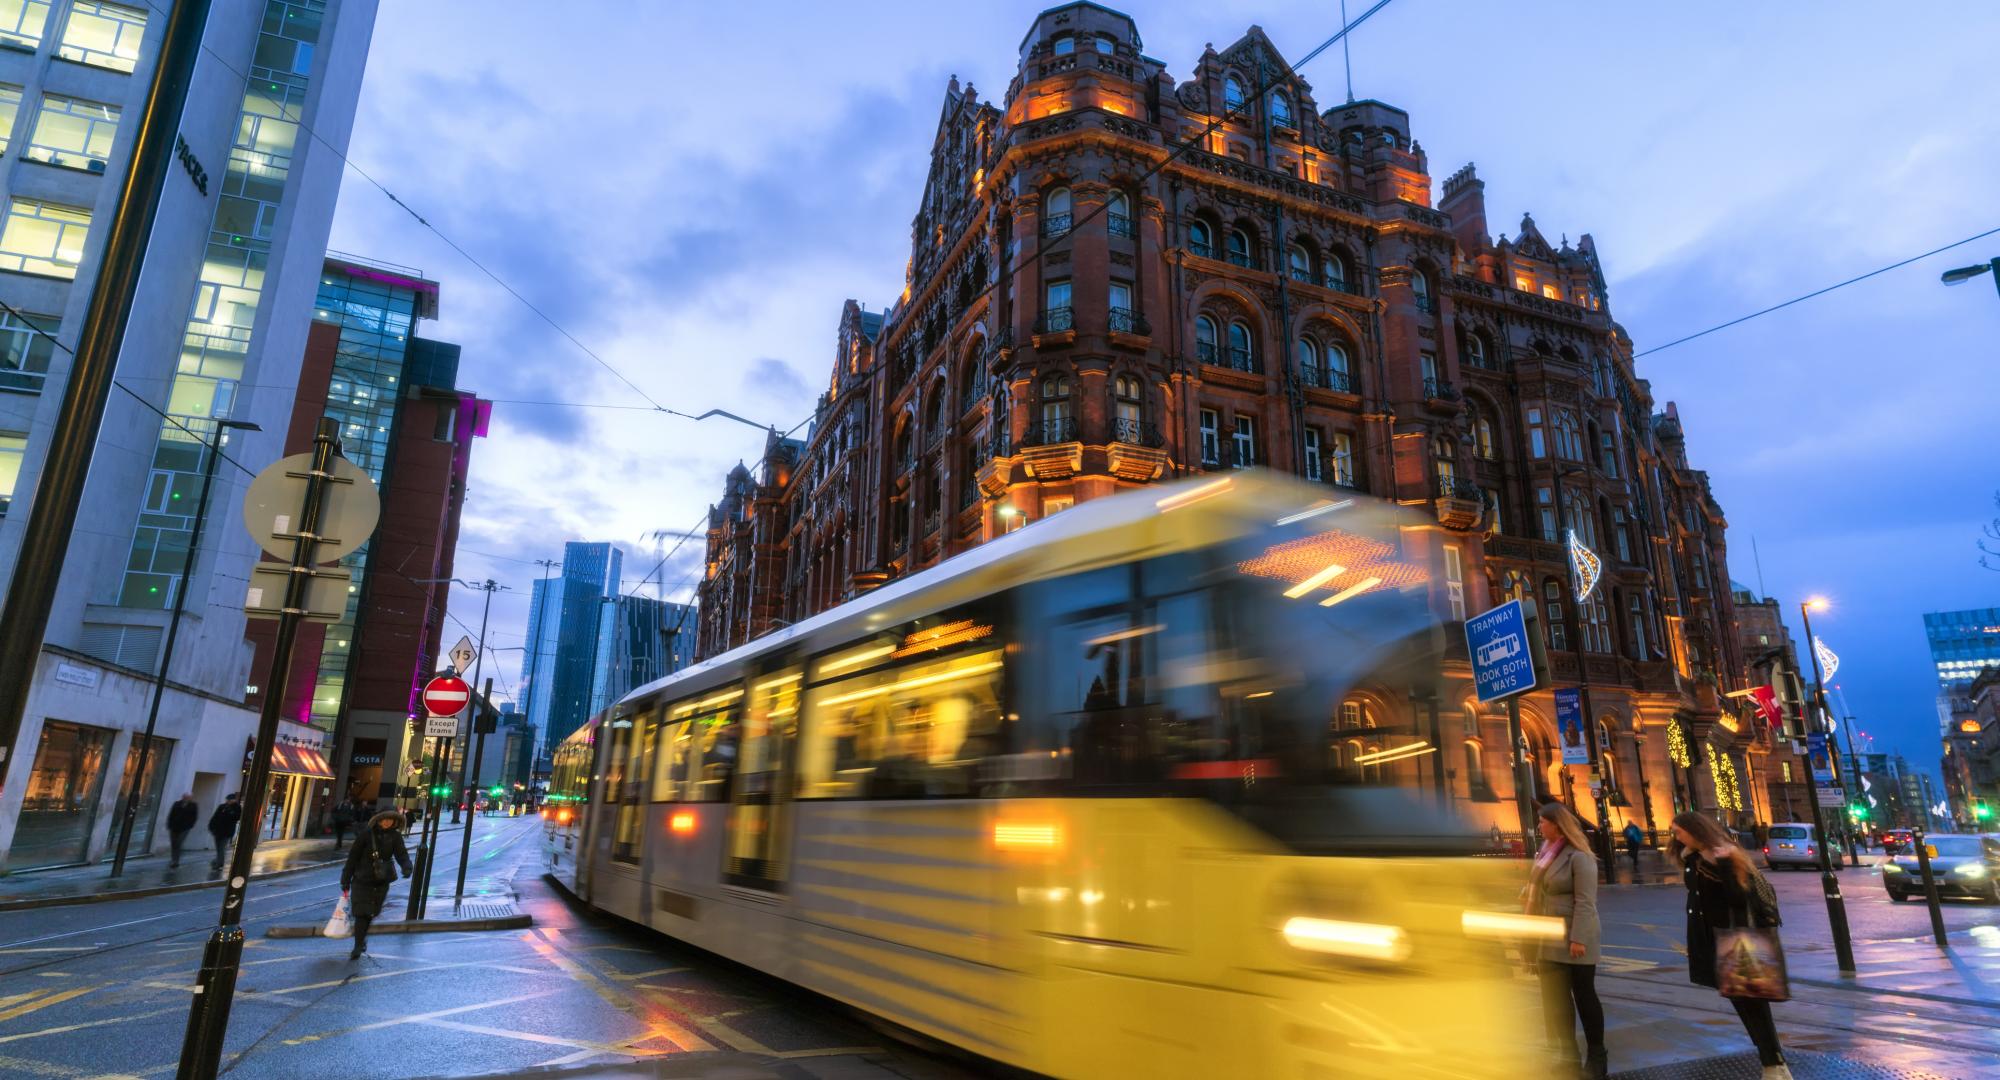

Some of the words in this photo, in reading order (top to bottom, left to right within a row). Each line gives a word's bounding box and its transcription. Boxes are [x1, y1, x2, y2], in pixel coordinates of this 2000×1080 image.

[1472, 608, 1513, 634] TRAMWAY
[455, 650, 470, 660] 15
[1477, 667, 1501, 684] LOOK
[1502, 658, 1528, 675] BOTH
[1491, 675, 1517, 692] WAYS
[429, 720, 455, 728] Except
